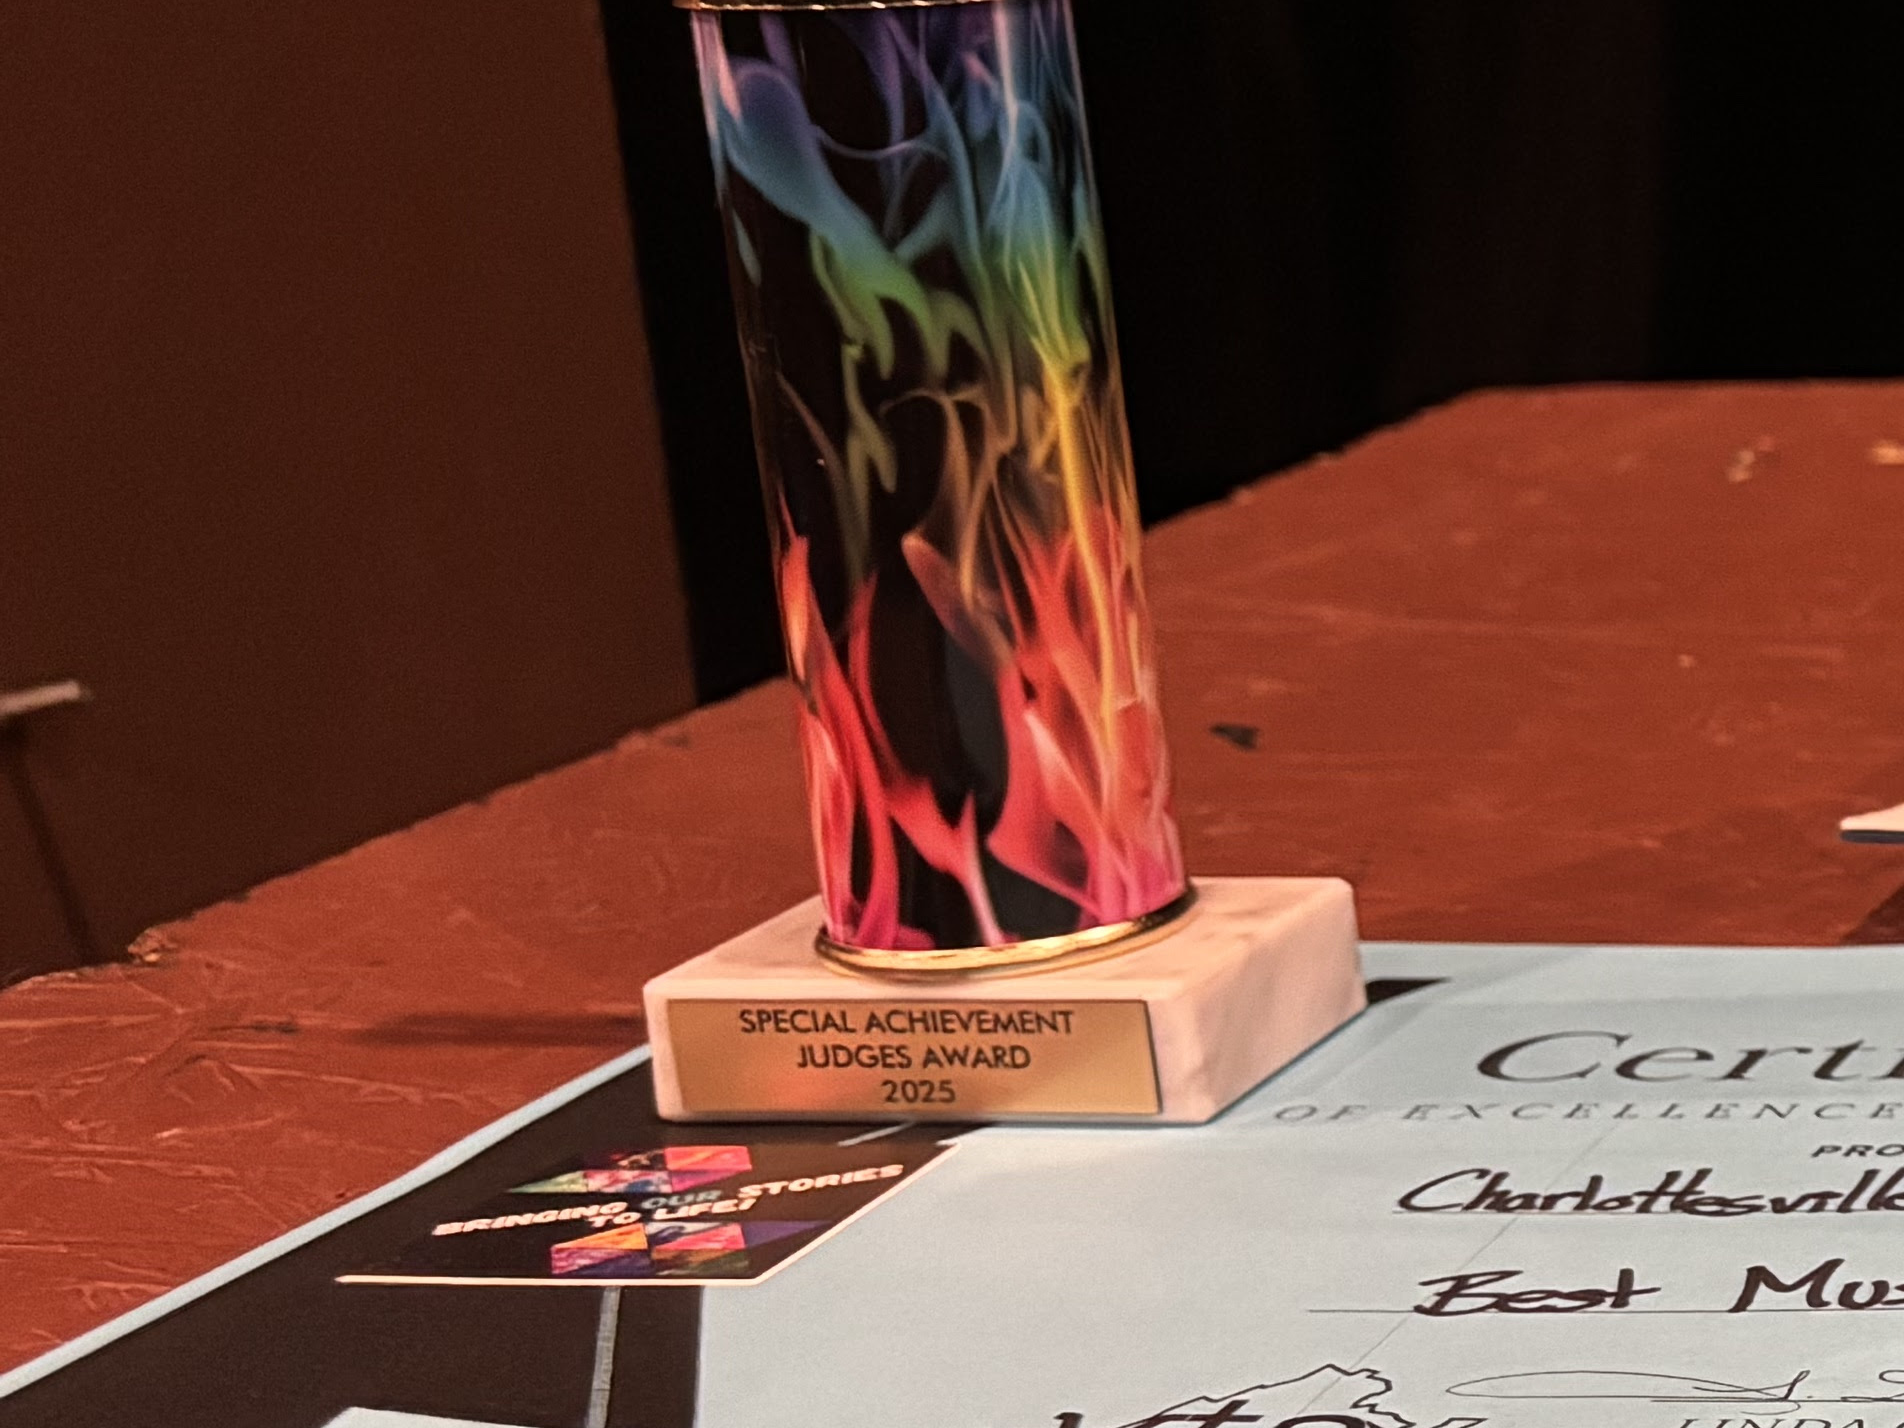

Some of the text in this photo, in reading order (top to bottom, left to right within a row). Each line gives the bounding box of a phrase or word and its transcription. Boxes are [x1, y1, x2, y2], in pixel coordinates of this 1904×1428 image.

[738, 1008, 1075, 1037] SPECIAL ACHIEVEMENT
[796, 1044, 1032, 1071] JUDGES AWARD
[880, 1079, 957, 1105] 2025
[1273, 1102, 1370, 1123] OF
[431, 1163, 906, 1237] BRINGING OUR STORIES
[587, 1210, 641, 1230] TO
[1413, 1266, 1665, 1317] Best
